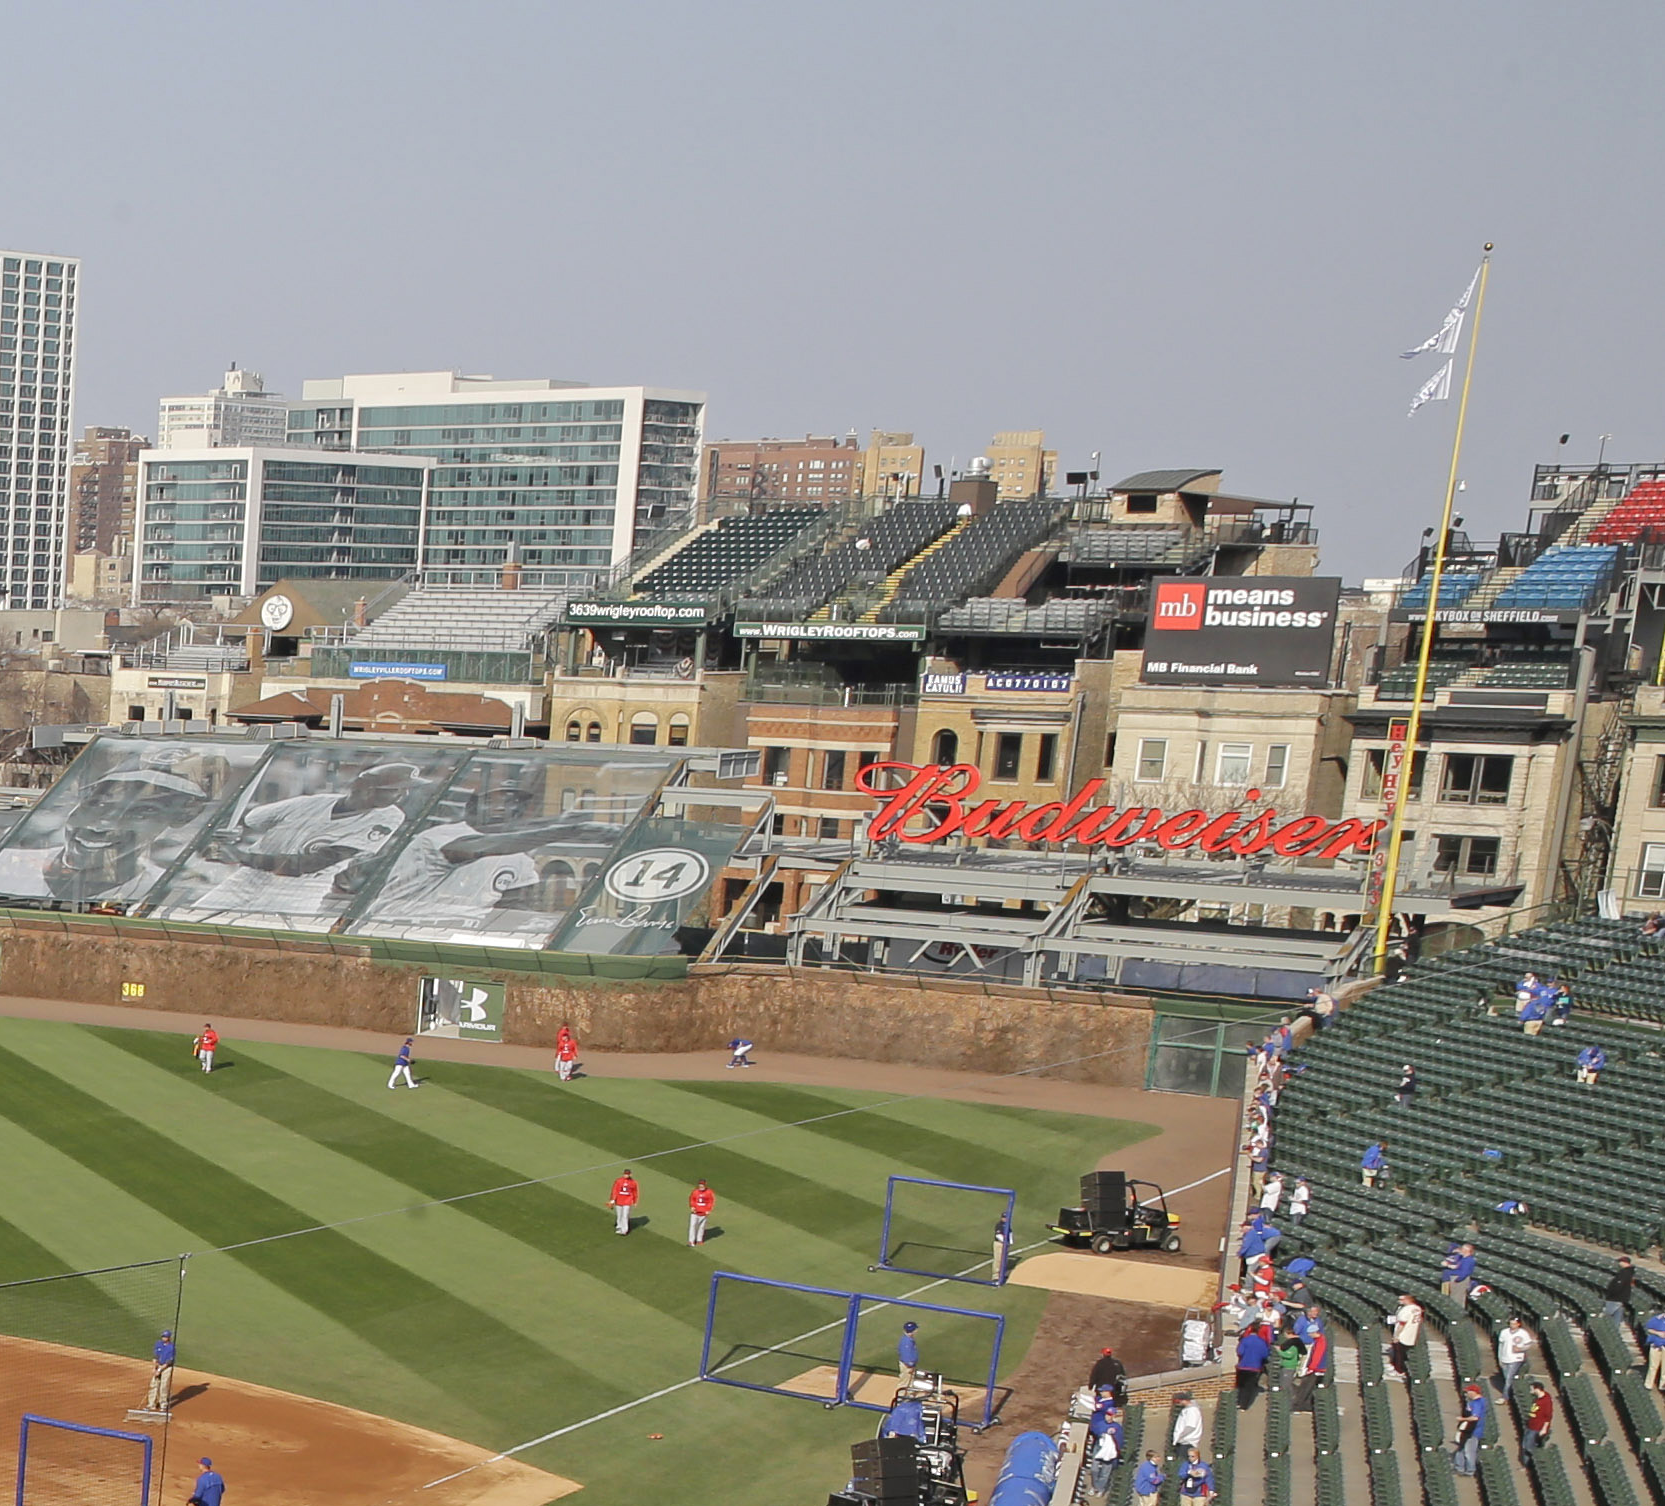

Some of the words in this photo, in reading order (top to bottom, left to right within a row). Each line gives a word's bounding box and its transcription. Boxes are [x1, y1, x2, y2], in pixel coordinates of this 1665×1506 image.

[569, 603, 705, 618] 3639wrigleyrooftop.com
[1159, 593, 1197, 617] mb
[1207, 589, 1294, 605] means
[1204, 606, 1323, 628] business
[739, 625, 918, 639] www.WRIGLEYROOFTOPS.com
[1147, 662, 1167, 673] MB
[1171, 662, 1225, 674] Financial
[1226, 663, 1258, 675] Bank
[855, 761, 1387, 859] Budweiser
[624, 859, 688, 889] 14
[122, 982, 155, 997] 368
